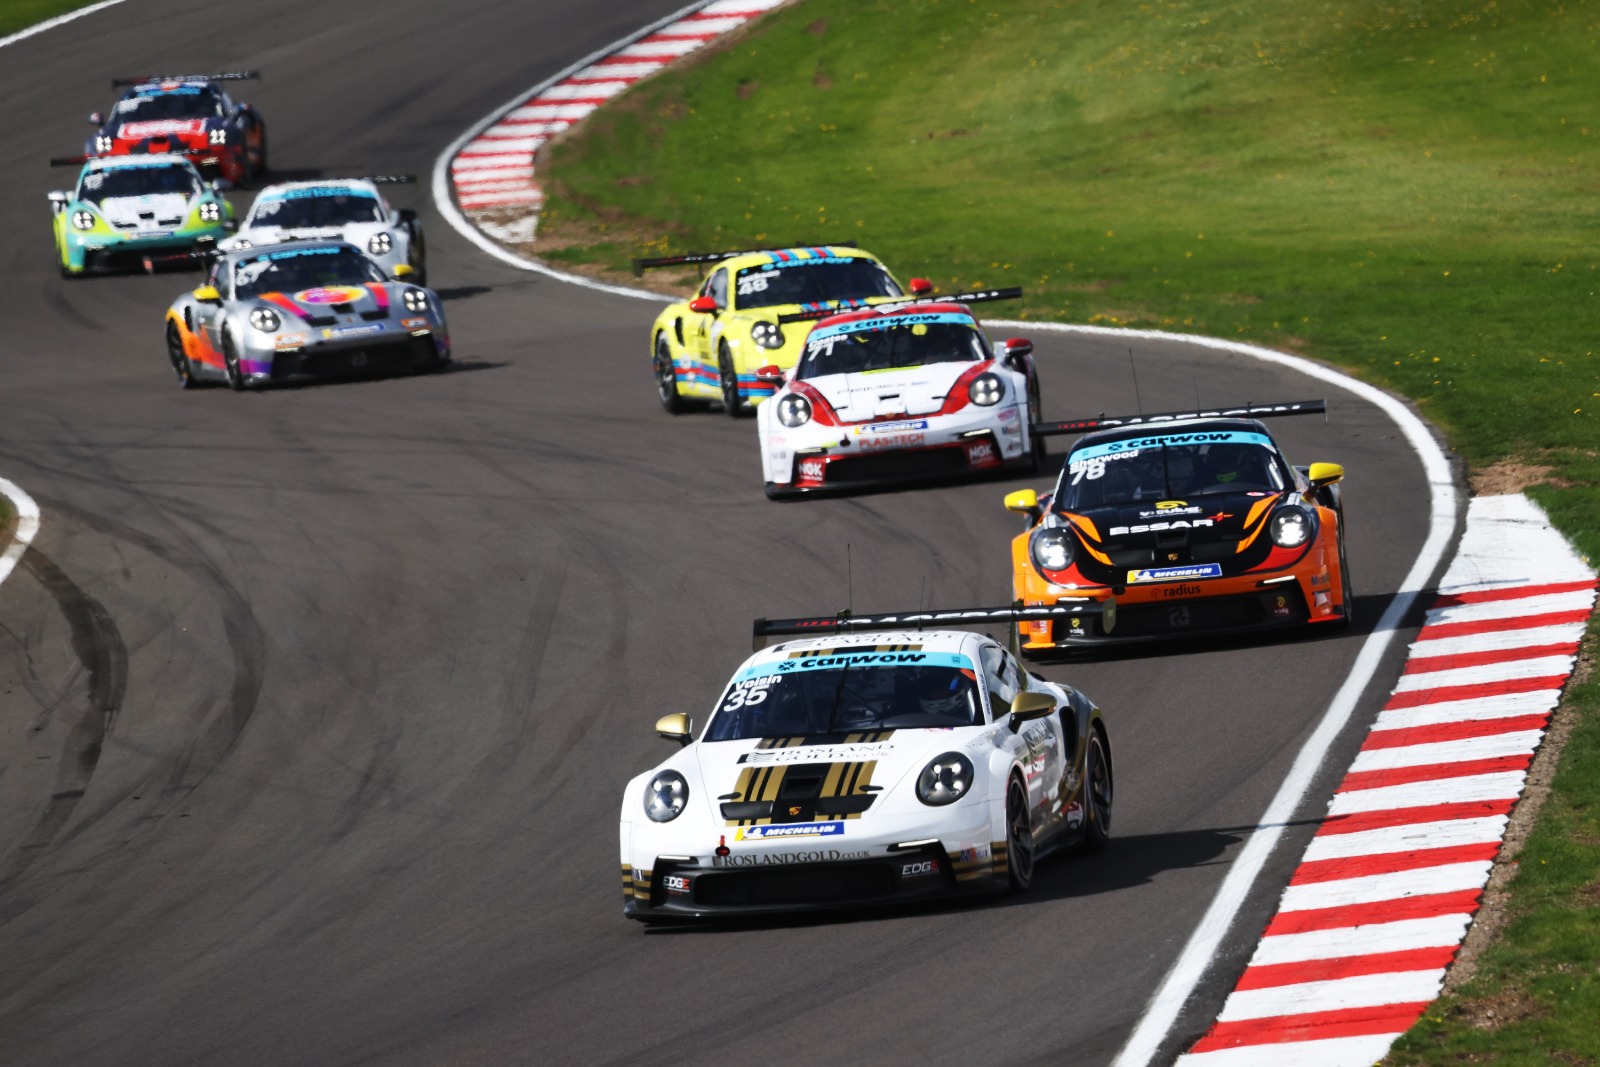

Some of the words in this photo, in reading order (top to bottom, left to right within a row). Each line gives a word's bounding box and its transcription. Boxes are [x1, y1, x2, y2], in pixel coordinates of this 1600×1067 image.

[855, 315, 940, 329] carwow
[808, 341, 835, 361] 71
[1127, 434, 1232, 448] carwow
[1070, 450, 1139, 472] Sherwood
[798, 462, 823, 476] NGK
[1070, 462, 1106, 486] 78
[1109, 519, 1214, 536] ESSAR
[1154, 567, 1212, 578] MICHELIN
[1163, 584, 1202, 597] radius
[800, 653, 927, 668] carwow
[736, 674, 783, 691] Voisin
[723, 684, 770, 712] 35
[765, 825, 836, 837] MICHELIN
[902, 857, 941, 876] EDGE
[663, 876, 692, 890] EDGE
